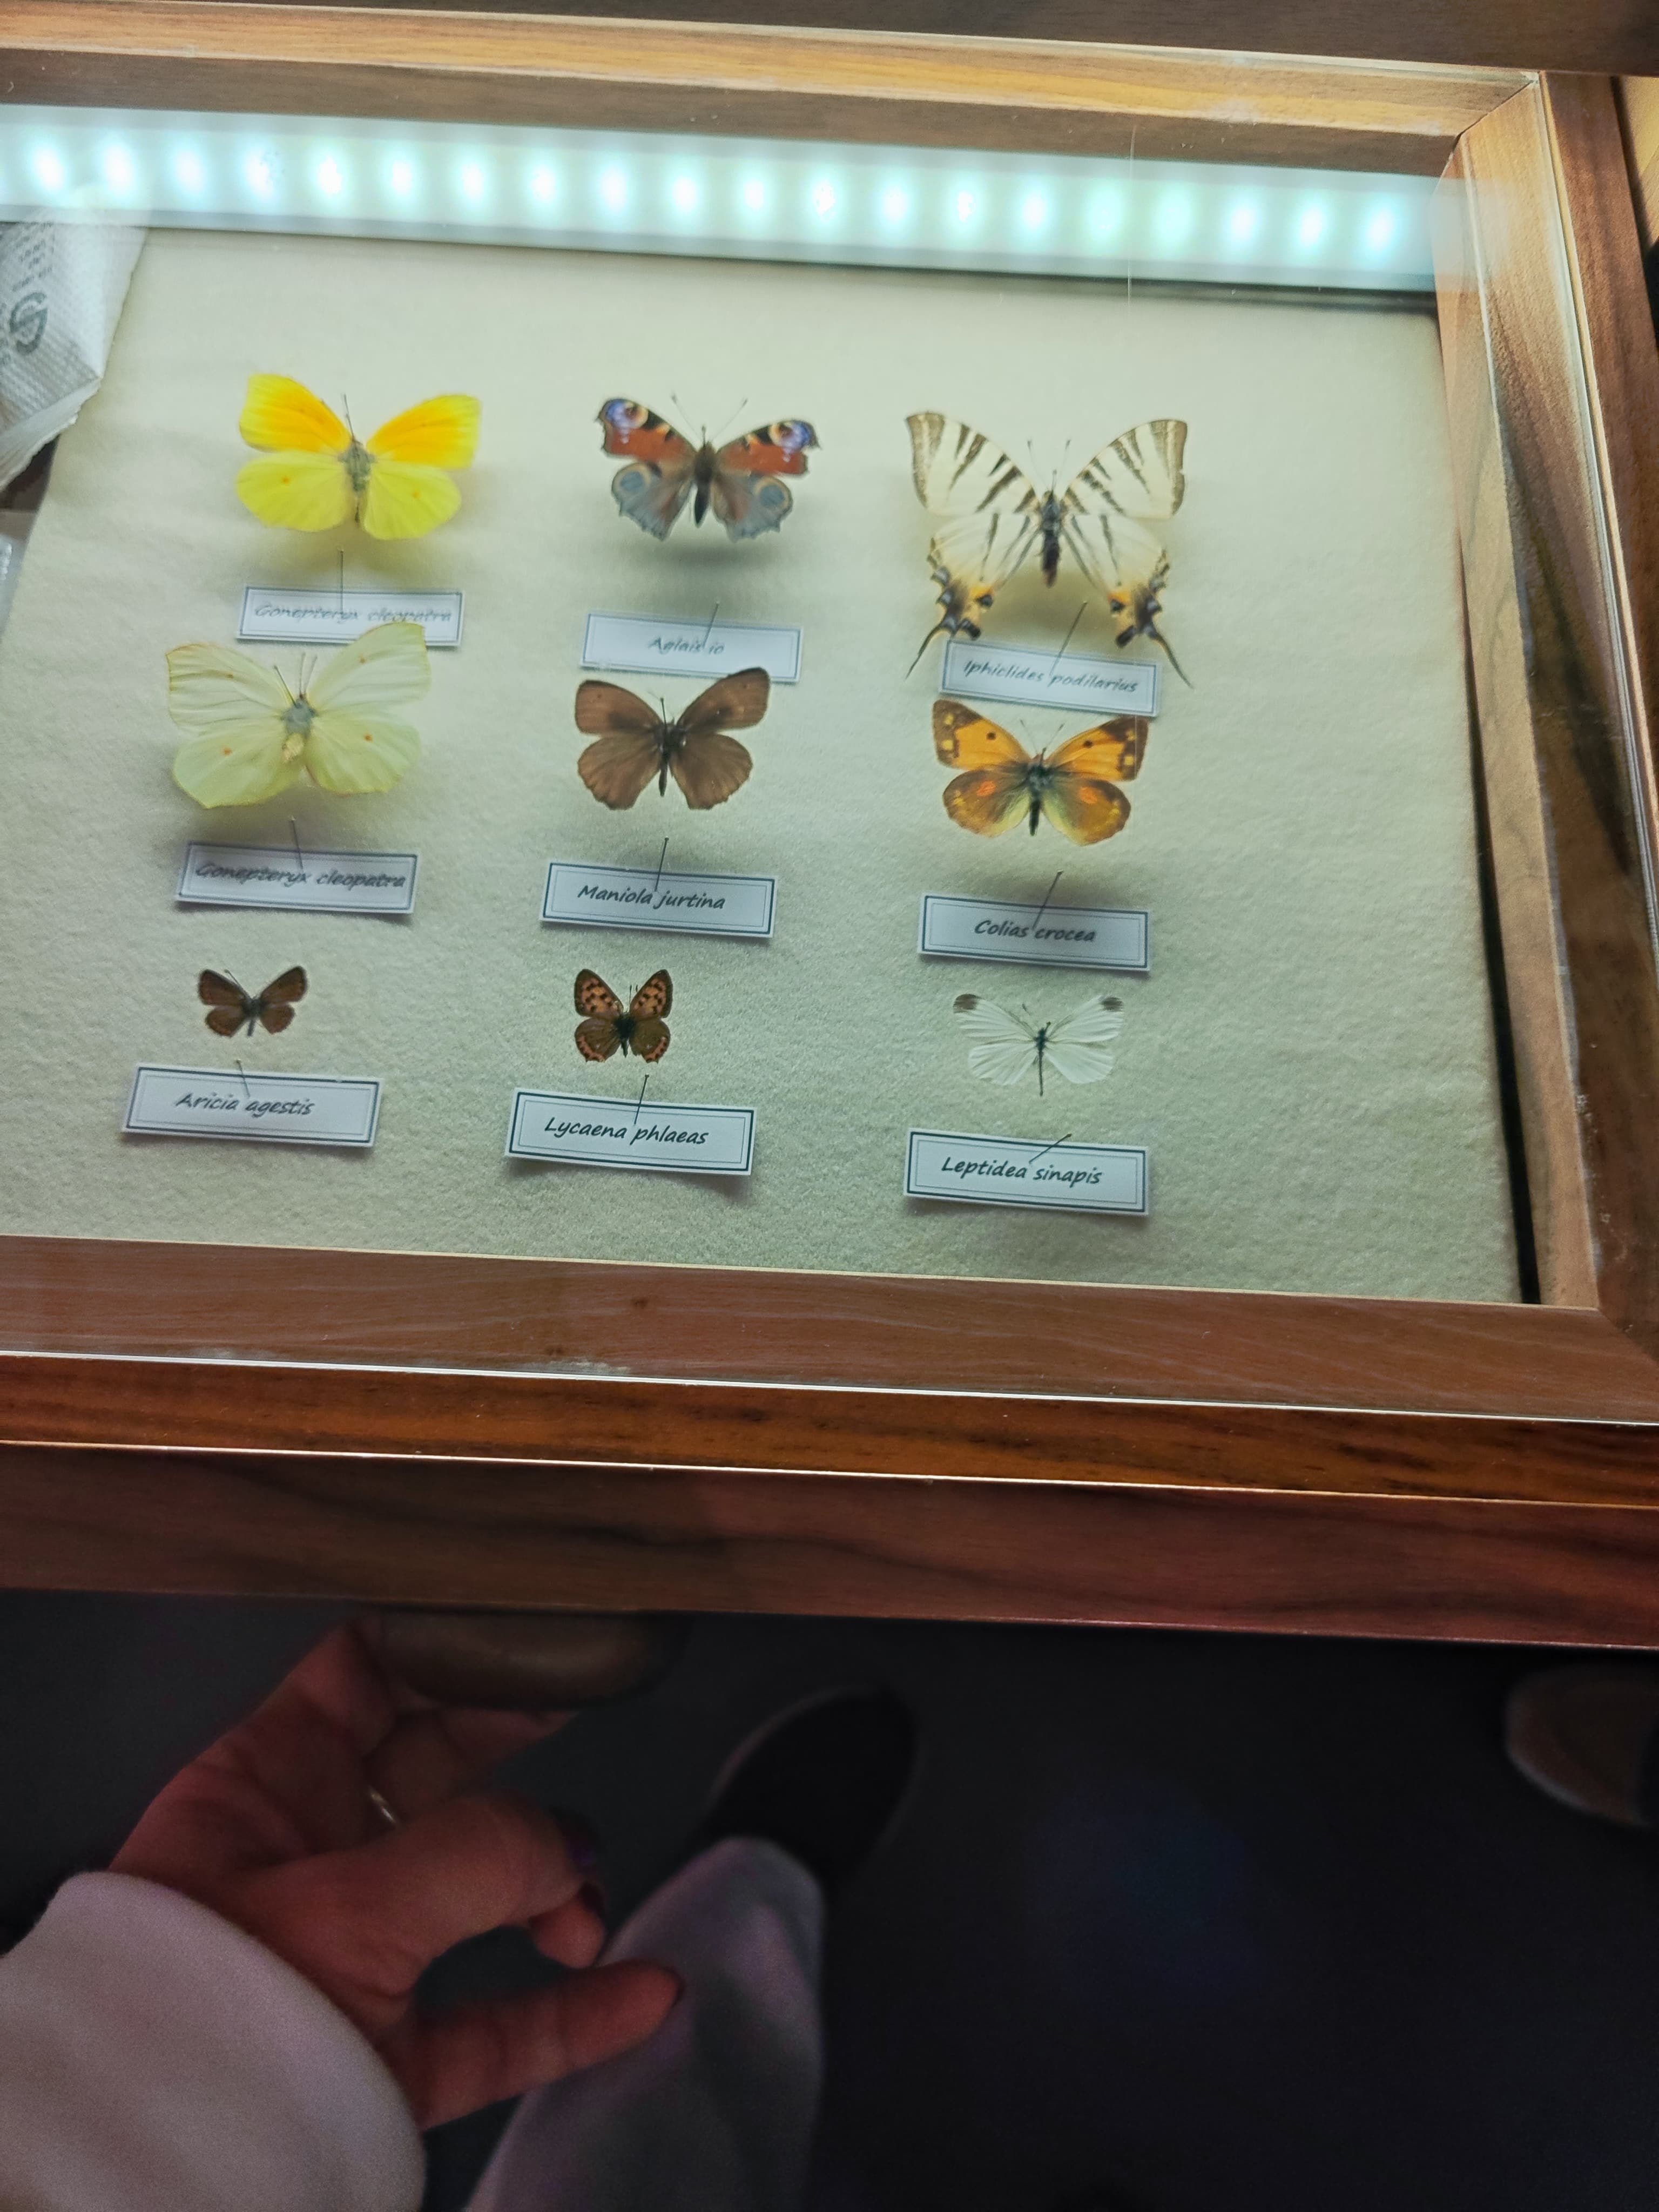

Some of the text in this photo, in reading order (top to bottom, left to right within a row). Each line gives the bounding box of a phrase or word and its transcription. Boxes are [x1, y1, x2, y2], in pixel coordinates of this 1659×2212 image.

[254, 605, 359, 624] Gonepteryx
[649, 635, 725, 655] Aglais io
[963, 660, 1044, 683] Iphiclides
[195, 863, 406, 891] Gonepteryx cleopatra
[577, 885, 726, 910] Maniola jurtina
[974, 919, 1097, 943] Colias crocea
[175, 1091, 316, 1118] Aricia agestis
[544, 1117, 709, 1146] Lycaena phlaeas
[941, 1156, 1103, 1188] Leptidea sinapis
